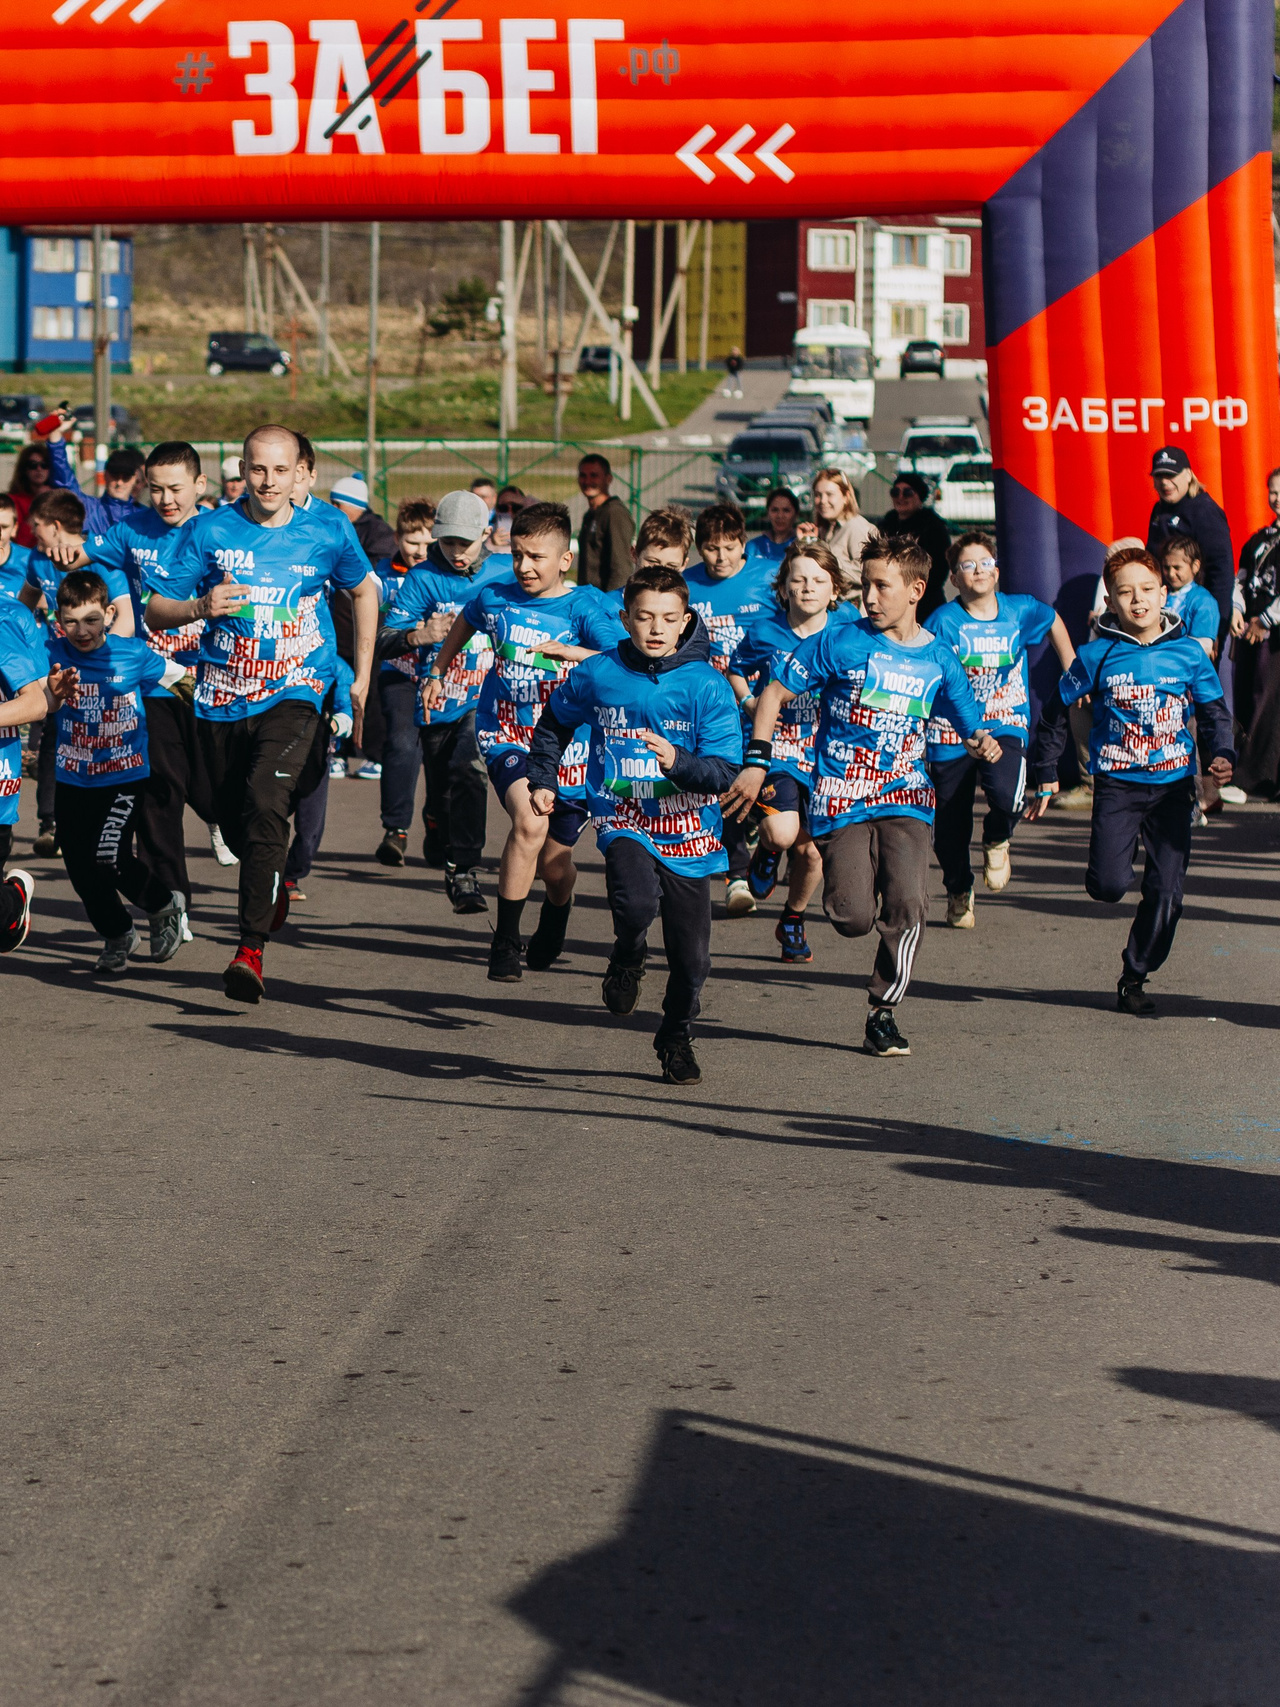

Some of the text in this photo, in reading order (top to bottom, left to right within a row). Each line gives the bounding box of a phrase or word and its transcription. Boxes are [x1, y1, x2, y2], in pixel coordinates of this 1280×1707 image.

[1022, 395, 1249, 434] ЗАБЕГ.РФ
[214, 548, 256, 572] 2024
[242, 585, 286, 605] 0027
[972, 636, 1009, 653] 10054
[882, 670, 925, 698] 10023
[1106, 671, 1135, 688] 2024
[593, 705, 628, 729] 2024
[630, 780, 655, 800] 1КМ
